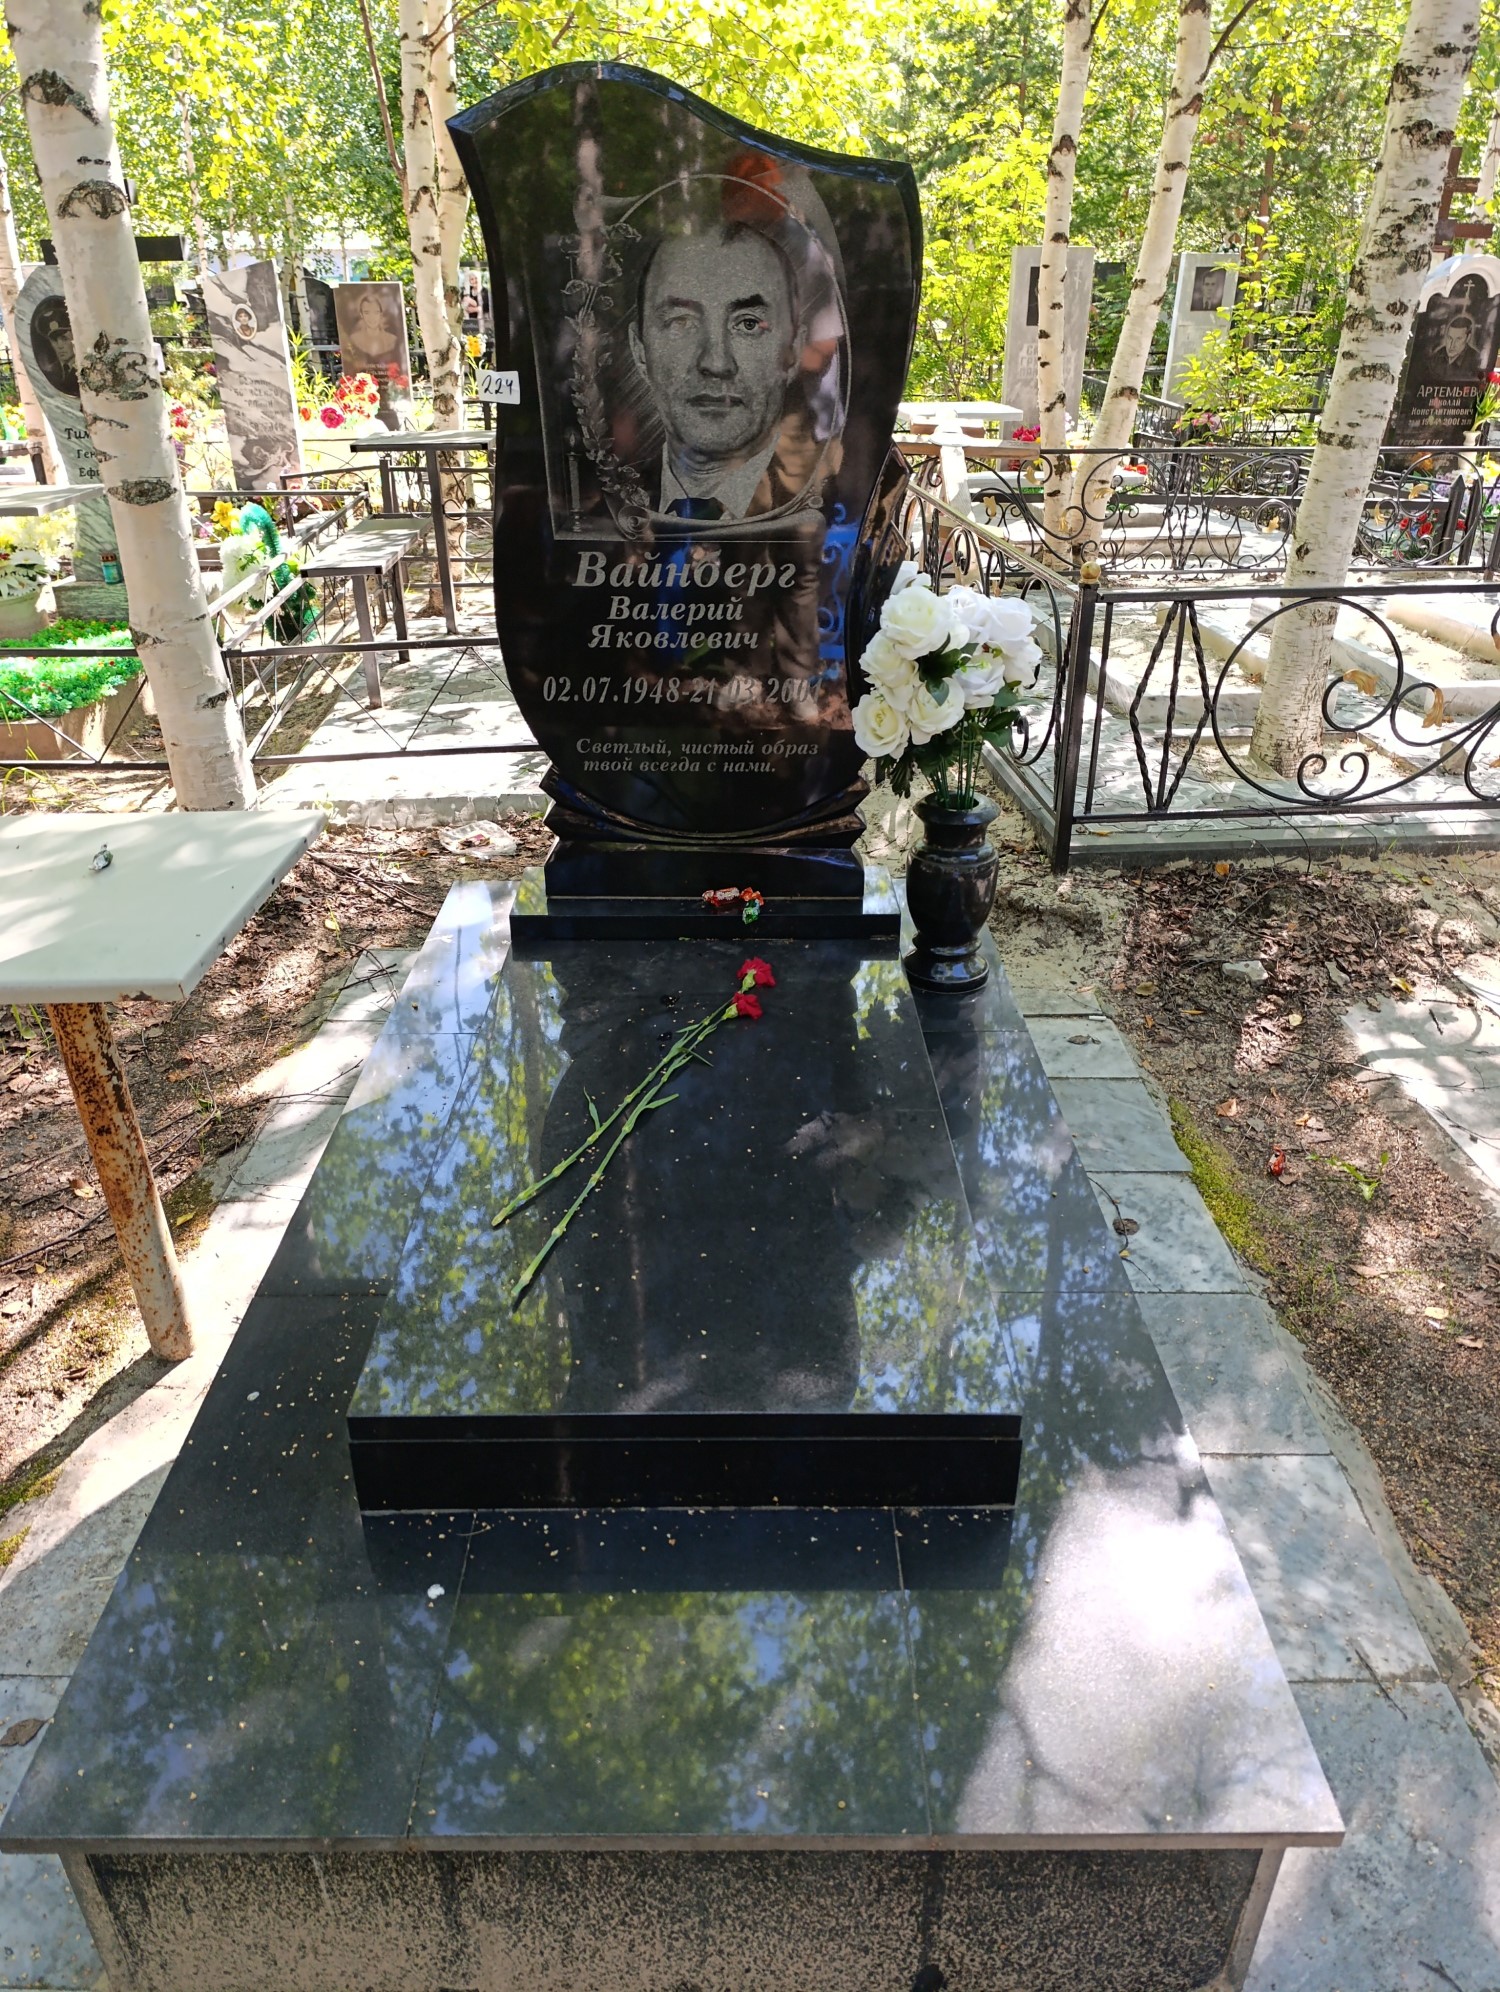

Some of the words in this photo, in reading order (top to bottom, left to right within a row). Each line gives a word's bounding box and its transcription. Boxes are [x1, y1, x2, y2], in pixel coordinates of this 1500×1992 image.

[481, 375, 513, 395] 224
[572, 549, 797, 597] Вайнберг
[607, 596, 744, 626] Валерий
[588, 624, 758, 649] Яковлевич
[576, 738, 672, 757] Светлый,
[681, 740, 754, 756] чистый
[762, 739, 820, 758] образ
[583, 757, 633, 772] твой
[640, 757, 700, 773] всегда
[707, 760, 717, 773] с
[723, 760, 777, 773] нами.
